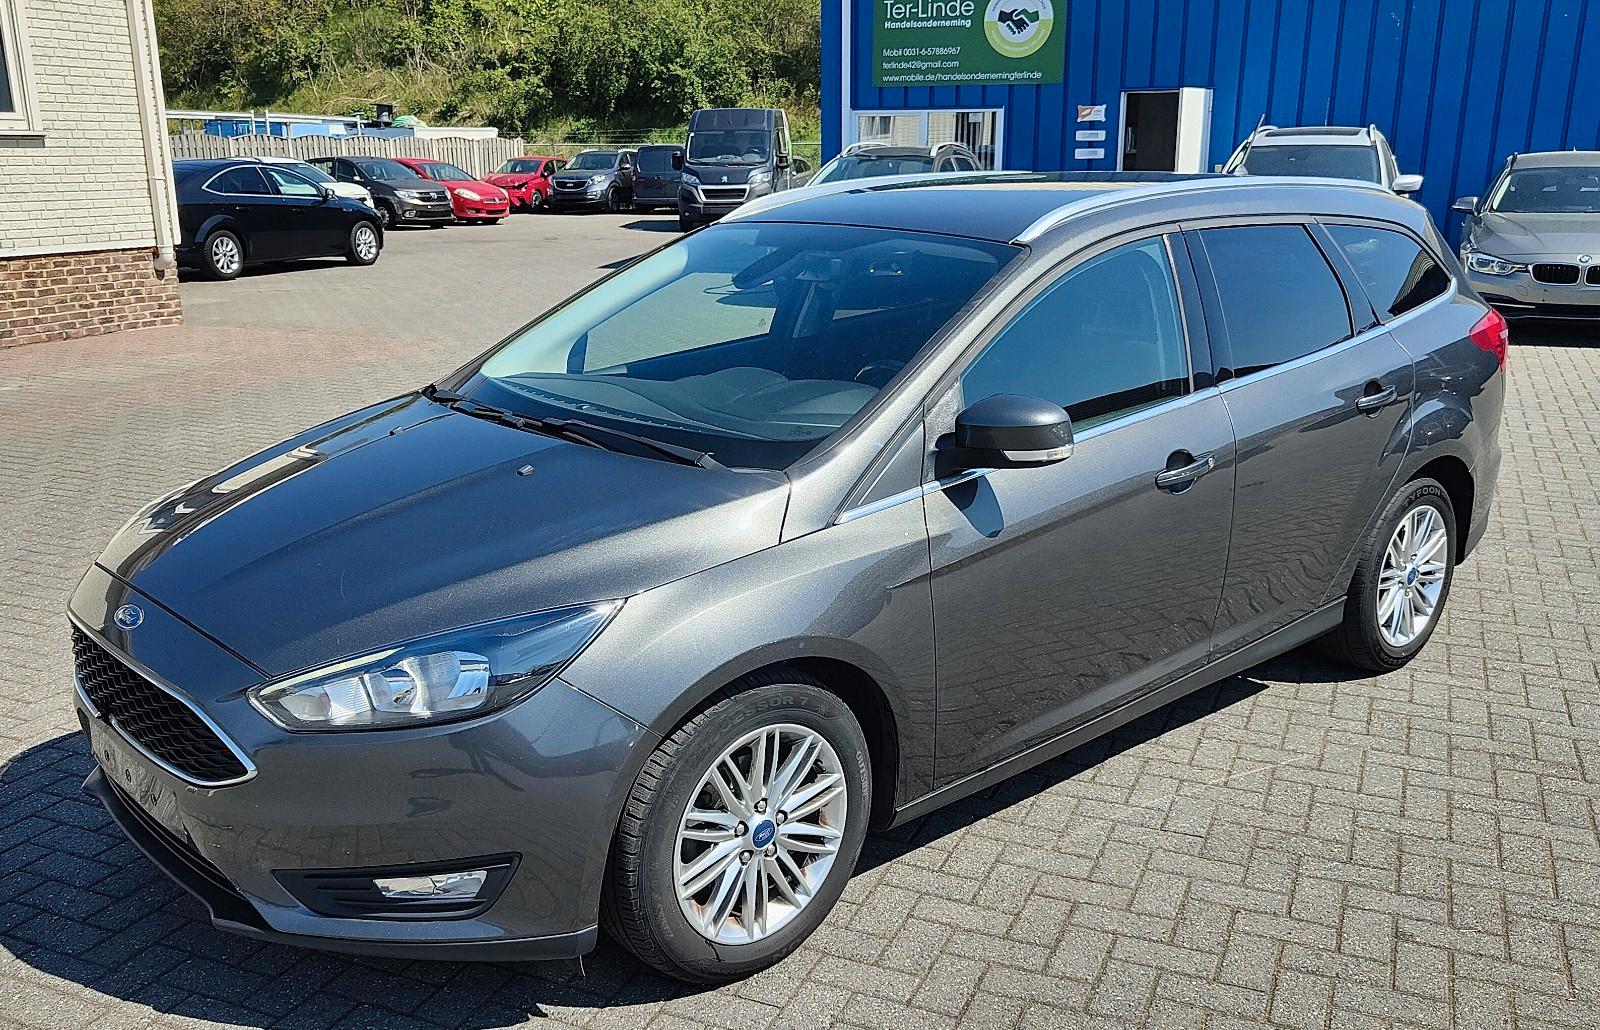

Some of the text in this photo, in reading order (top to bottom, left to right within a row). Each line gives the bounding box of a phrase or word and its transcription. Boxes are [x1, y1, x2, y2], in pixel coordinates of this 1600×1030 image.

[884, 0, 975, 18] Ter-Linde
[884, 18, 972, 29] Handelsonderneming
[882, 47, 961, 57] Mobil 0031-6-57886967
